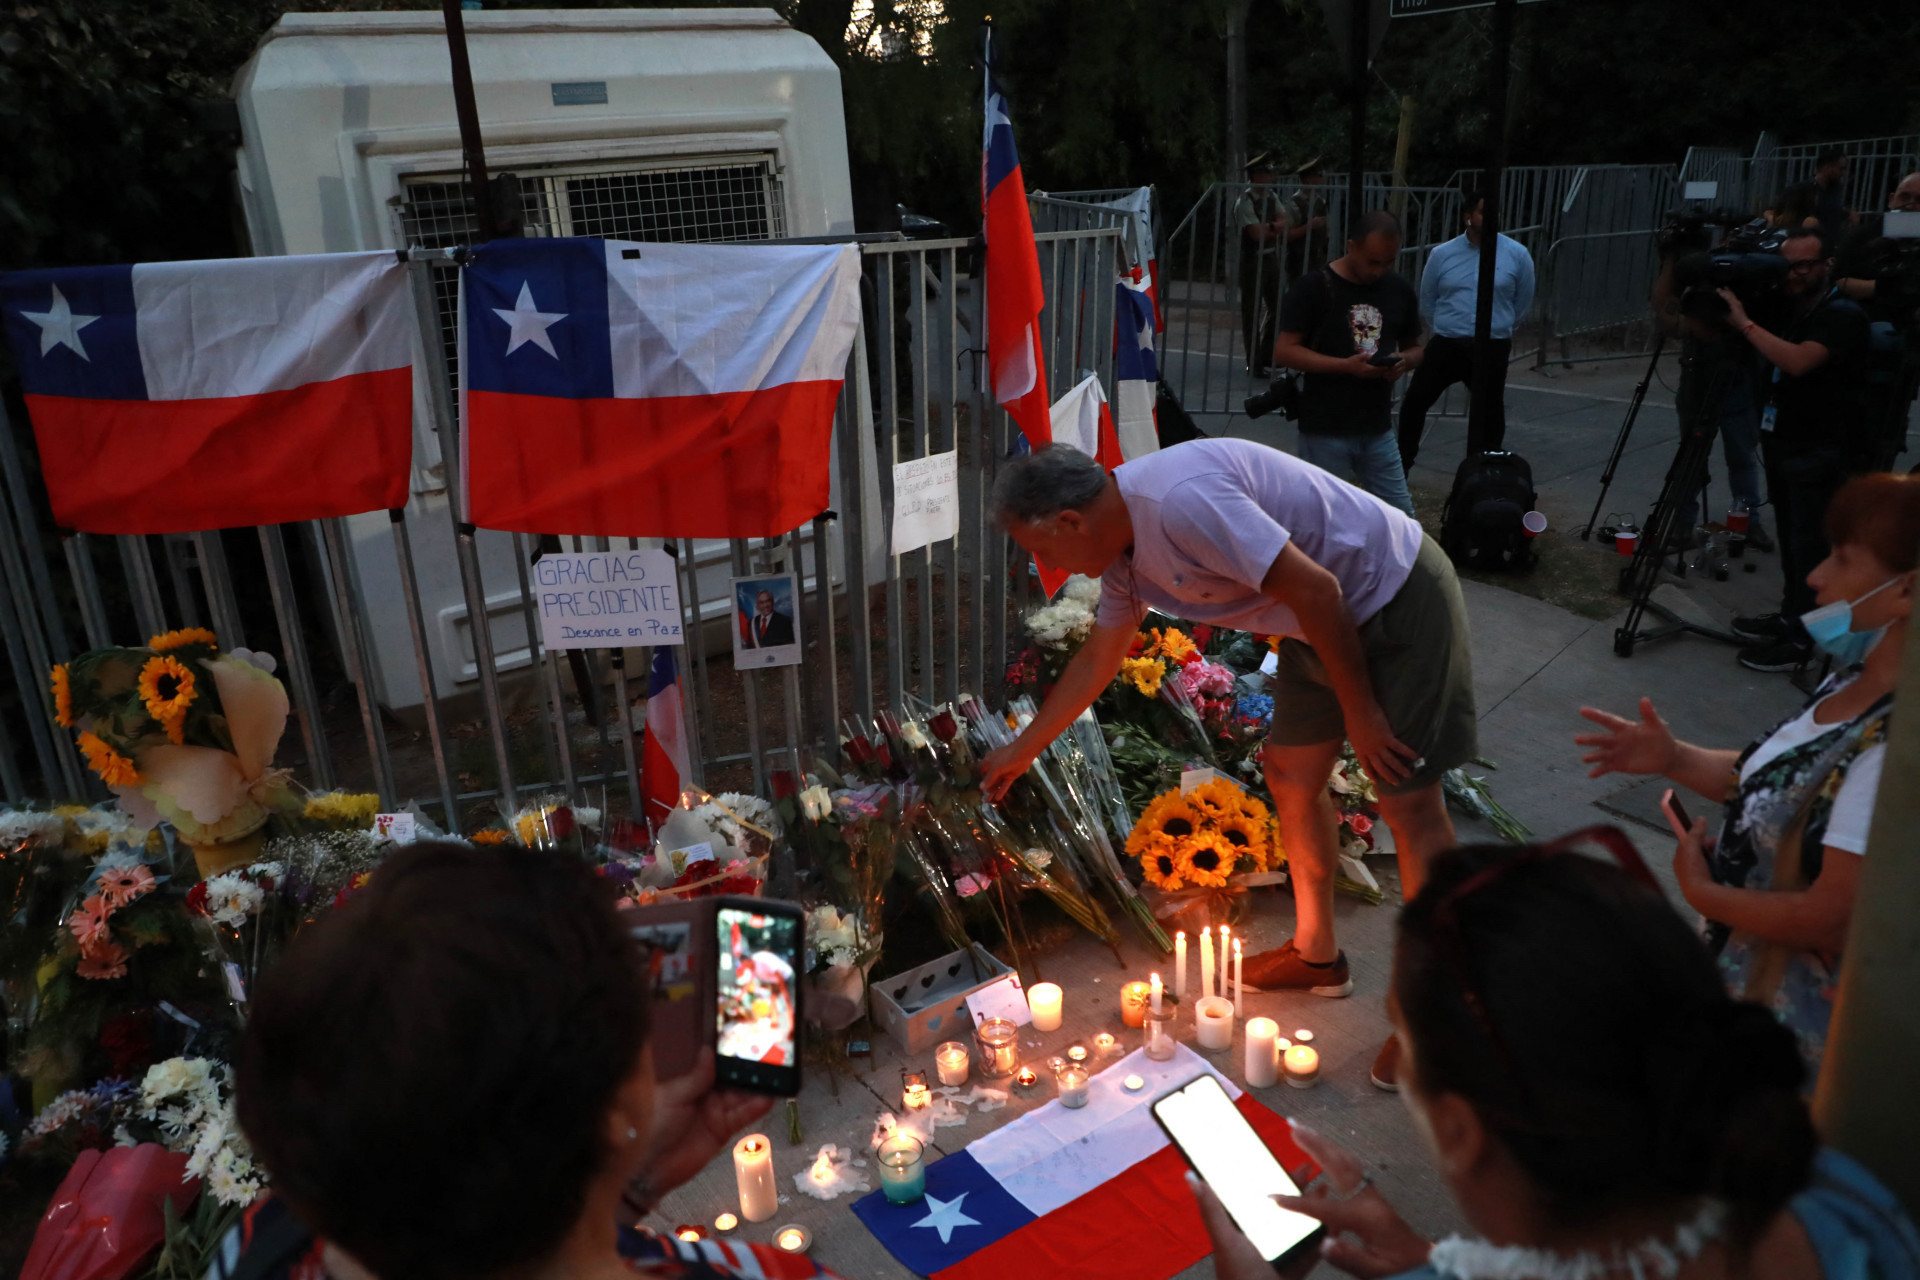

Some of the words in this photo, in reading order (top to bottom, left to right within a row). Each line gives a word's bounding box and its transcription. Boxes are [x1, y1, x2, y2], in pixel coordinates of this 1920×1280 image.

[537, 555, 646, 586] GRACIAS
[543, 585, 675, 618] PRESIDENTE
[561, 626, 622, 639] Descance
[627, 627, 642, 637] en
[645, 619, 682, 636] Paz
